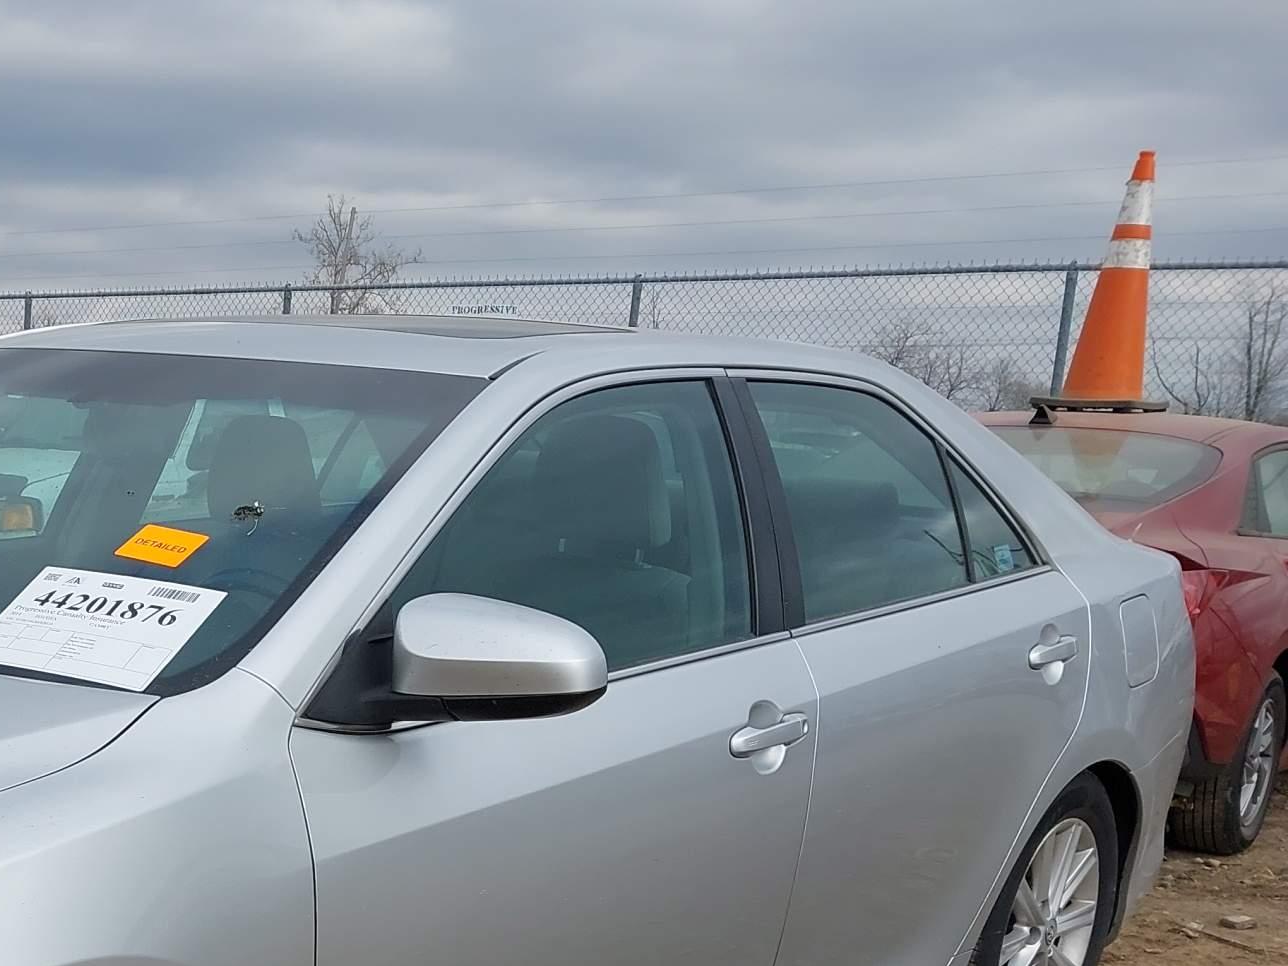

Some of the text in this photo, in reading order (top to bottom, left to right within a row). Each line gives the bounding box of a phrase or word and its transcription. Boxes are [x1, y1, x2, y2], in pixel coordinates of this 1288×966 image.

[452, 305, 518, 314] PROGRESSIVE
[134, 538, 187, 553] DETAILED
[14, 604, 56, 615] Progressive
[89, 614, 126, 626] Insurance
[34, 590, 184, 627] 44201876
